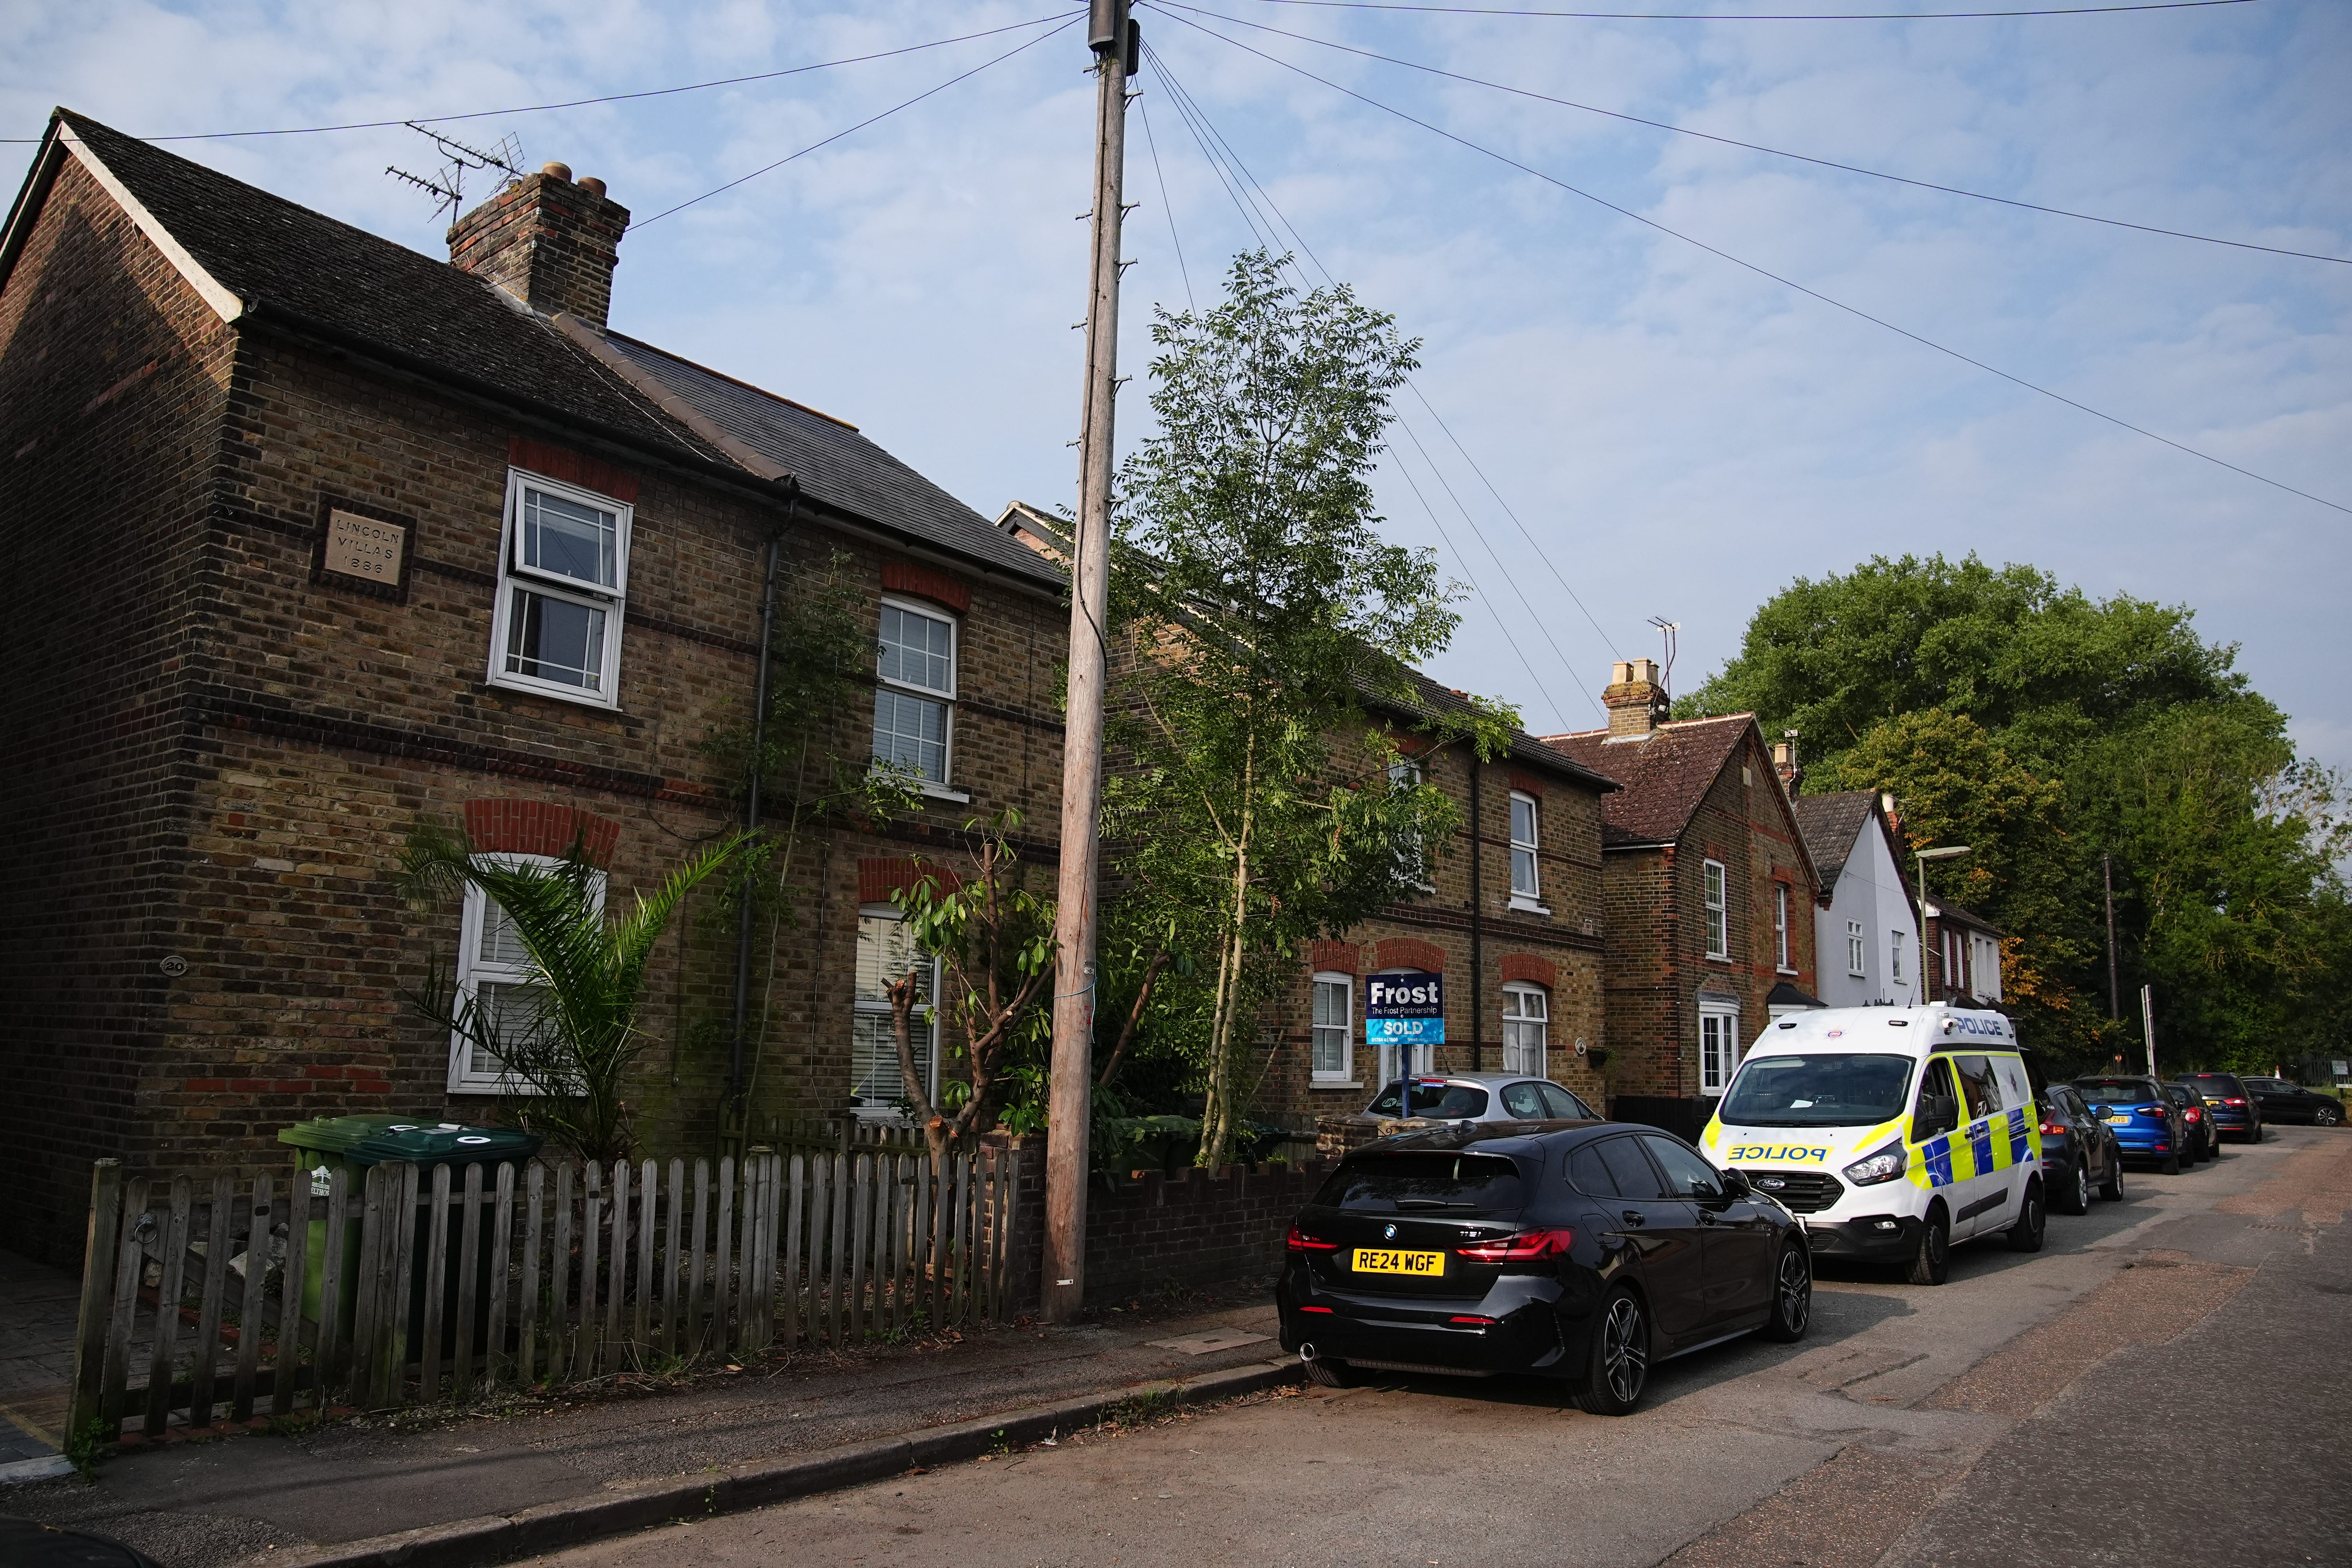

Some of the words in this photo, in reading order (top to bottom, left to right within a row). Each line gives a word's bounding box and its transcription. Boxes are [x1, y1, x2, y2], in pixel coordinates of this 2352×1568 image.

[336, 519, 399, 544] LINCOLN
[338, 537, 393, 559] VILLAS
[343, 556, 383, 573] 1886
[1371, 982, 1438, 1004] Frost
[1400, 1006, 1437, 1015] Partnership
[1384, 1022, 1423, 1035] SOLD
[1954, 1017, 2003, 1036] POLICE
[1359, 1252, 1399, 1269] RE24
[1405, 1254, 1437, 1271] WGF
